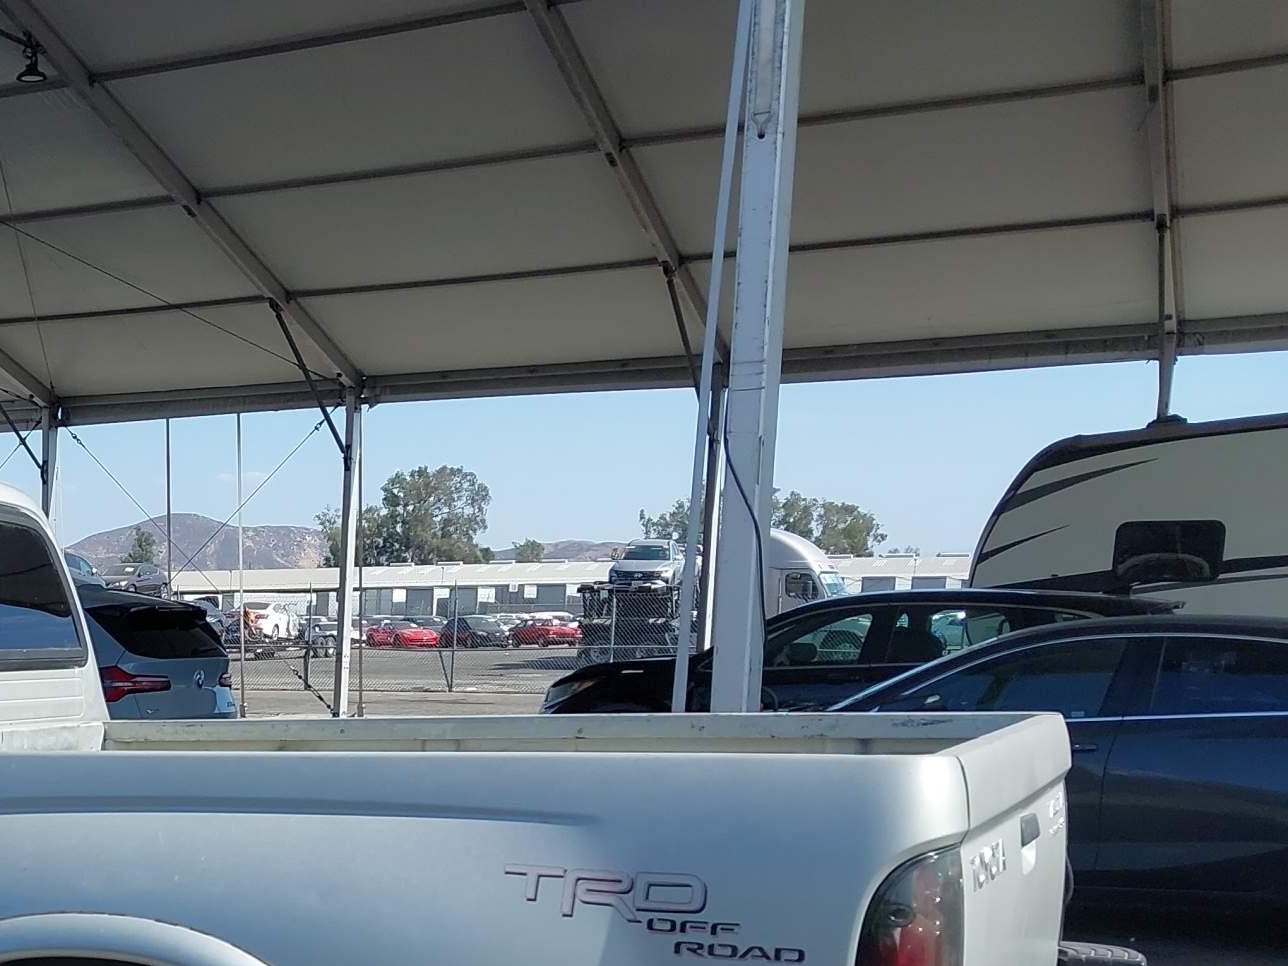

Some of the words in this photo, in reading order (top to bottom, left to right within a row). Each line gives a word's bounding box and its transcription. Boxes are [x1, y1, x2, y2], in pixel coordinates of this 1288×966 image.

[504, 863, 708, 924] TRD
[646, 917, 741, 936] OFF
[673, 940, 806, 964] ROAD
